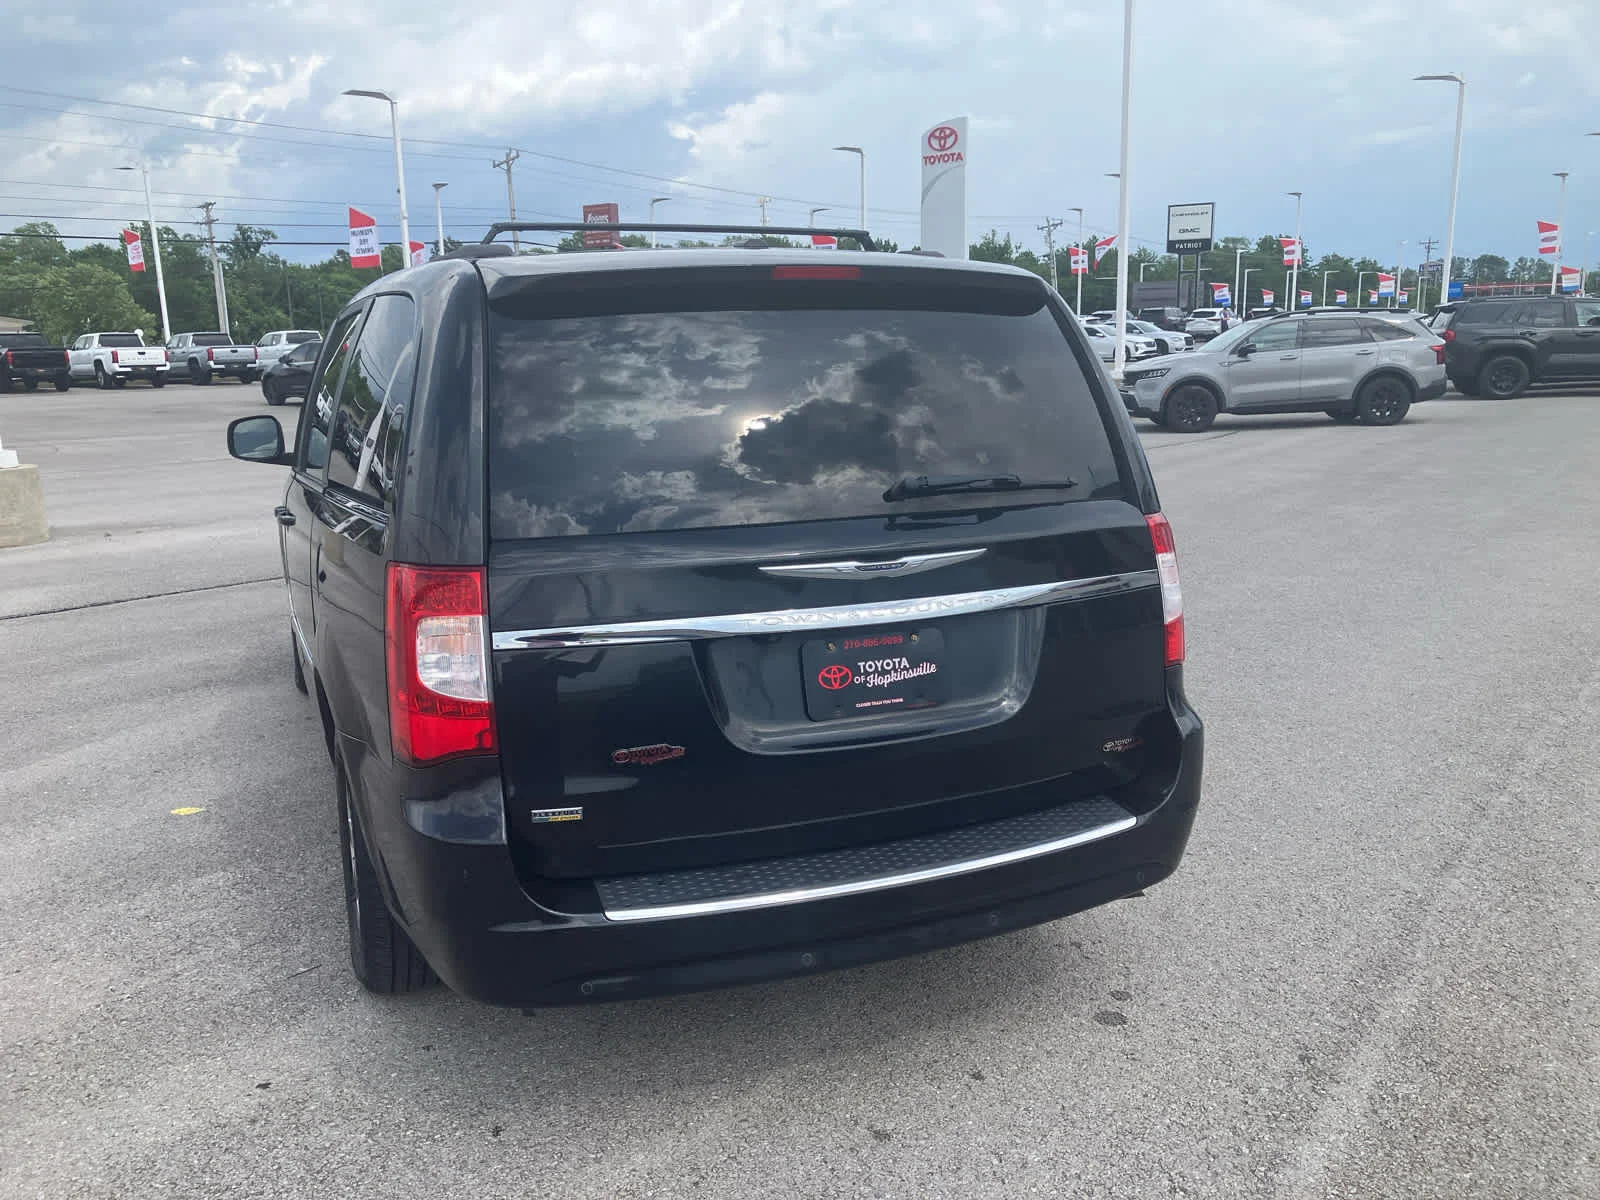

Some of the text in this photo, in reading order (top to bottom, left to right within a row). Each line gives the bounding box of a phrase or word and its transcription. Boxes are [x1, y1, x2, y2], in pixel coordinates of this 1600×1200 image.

[922, 152, 964, 167] TOYOTA
[737, 612, 837, 631] TOWN
[868, 593, 1009, 619] COUNTRY
[853, 662, 937, 688] OF Hopkinsville
[857, 656, 910, 673] TOYOTA
